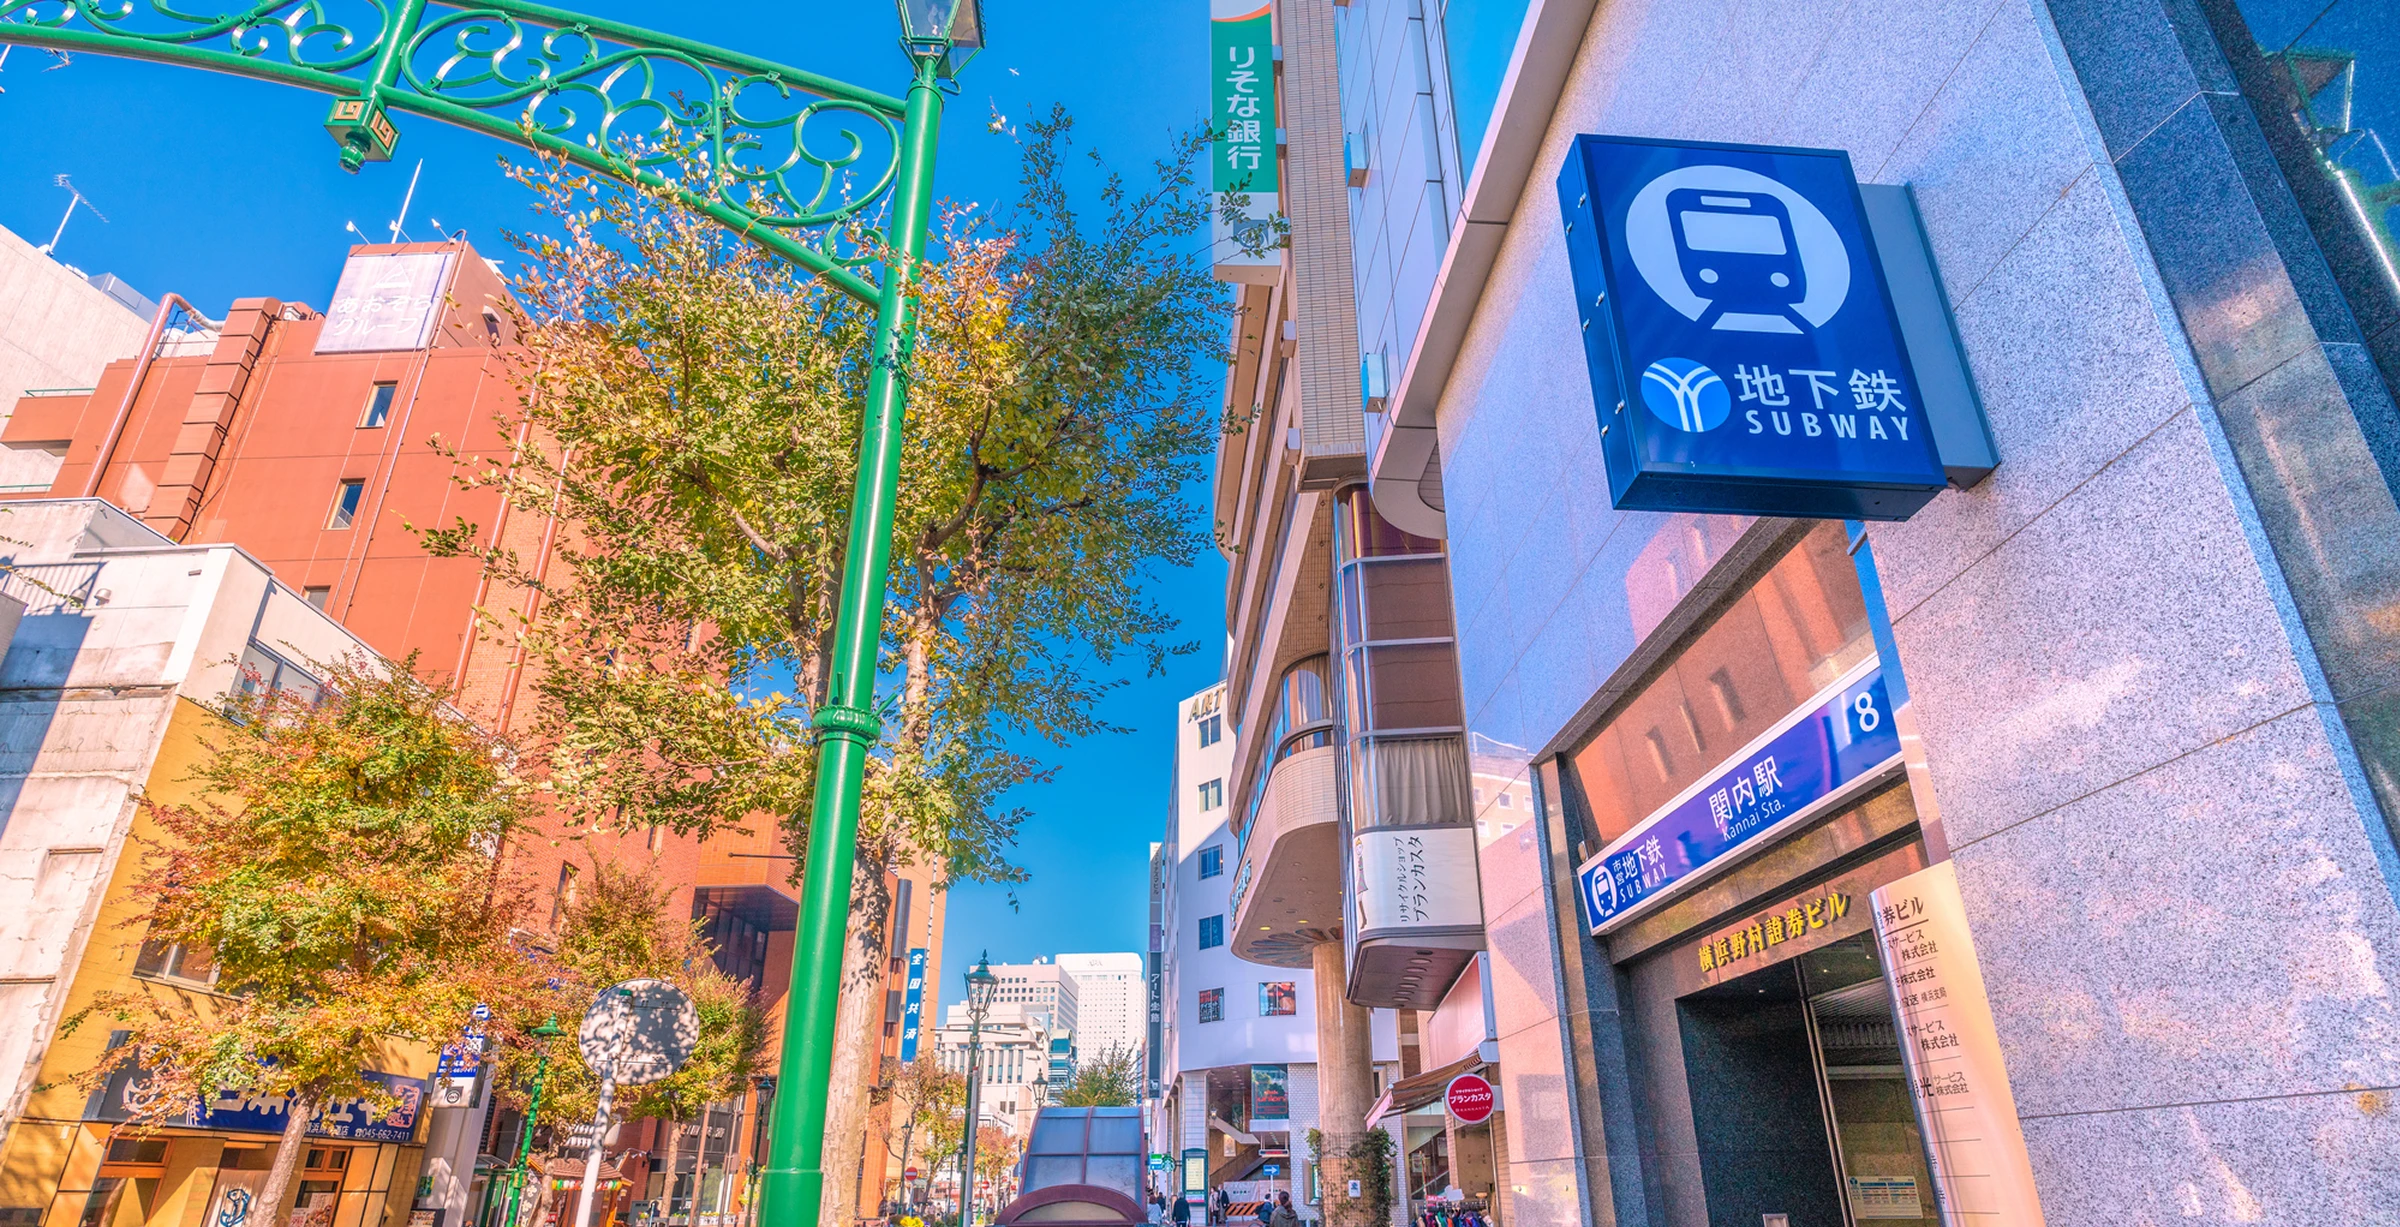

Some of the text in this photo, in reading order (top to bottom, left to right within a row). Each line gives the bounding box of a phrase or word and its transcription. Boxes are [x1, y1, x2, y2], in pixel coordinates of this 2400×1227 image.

[1226, 46, 1262, 170] りそな銀行
[1734, 364, 1907, 413] 地下鉄
[1746, 409, 1909, 441] SUBWAY
[1854, 691, 1880, 732] 8
[1708, 755, 1783, 828] 関内駅
[1723, 798, 1786, 842] Kannai Sta.
[1393, 836, 1411, 922] リサイクルショップ
[1408, 836, 1430, 922] ブランカスタ
[1622, 835, 1664, 879] 地下鉄
[1620, 862, 1667, 903] SUBWAY
[1698, 893, 1847, 973] 横浜野村證券ビル
[1902, 940, 1939, 961] 株式会社
[903, 953, 924, 1040] 全国共済
[1921, 1033, 1960, 1052] 株式会社
[1934, 1072, 1966, 1085] サービス
[1936, 1083, 1969, 1096] 株式会社
[361, 1128, 410, 1140] 045-662-7411
